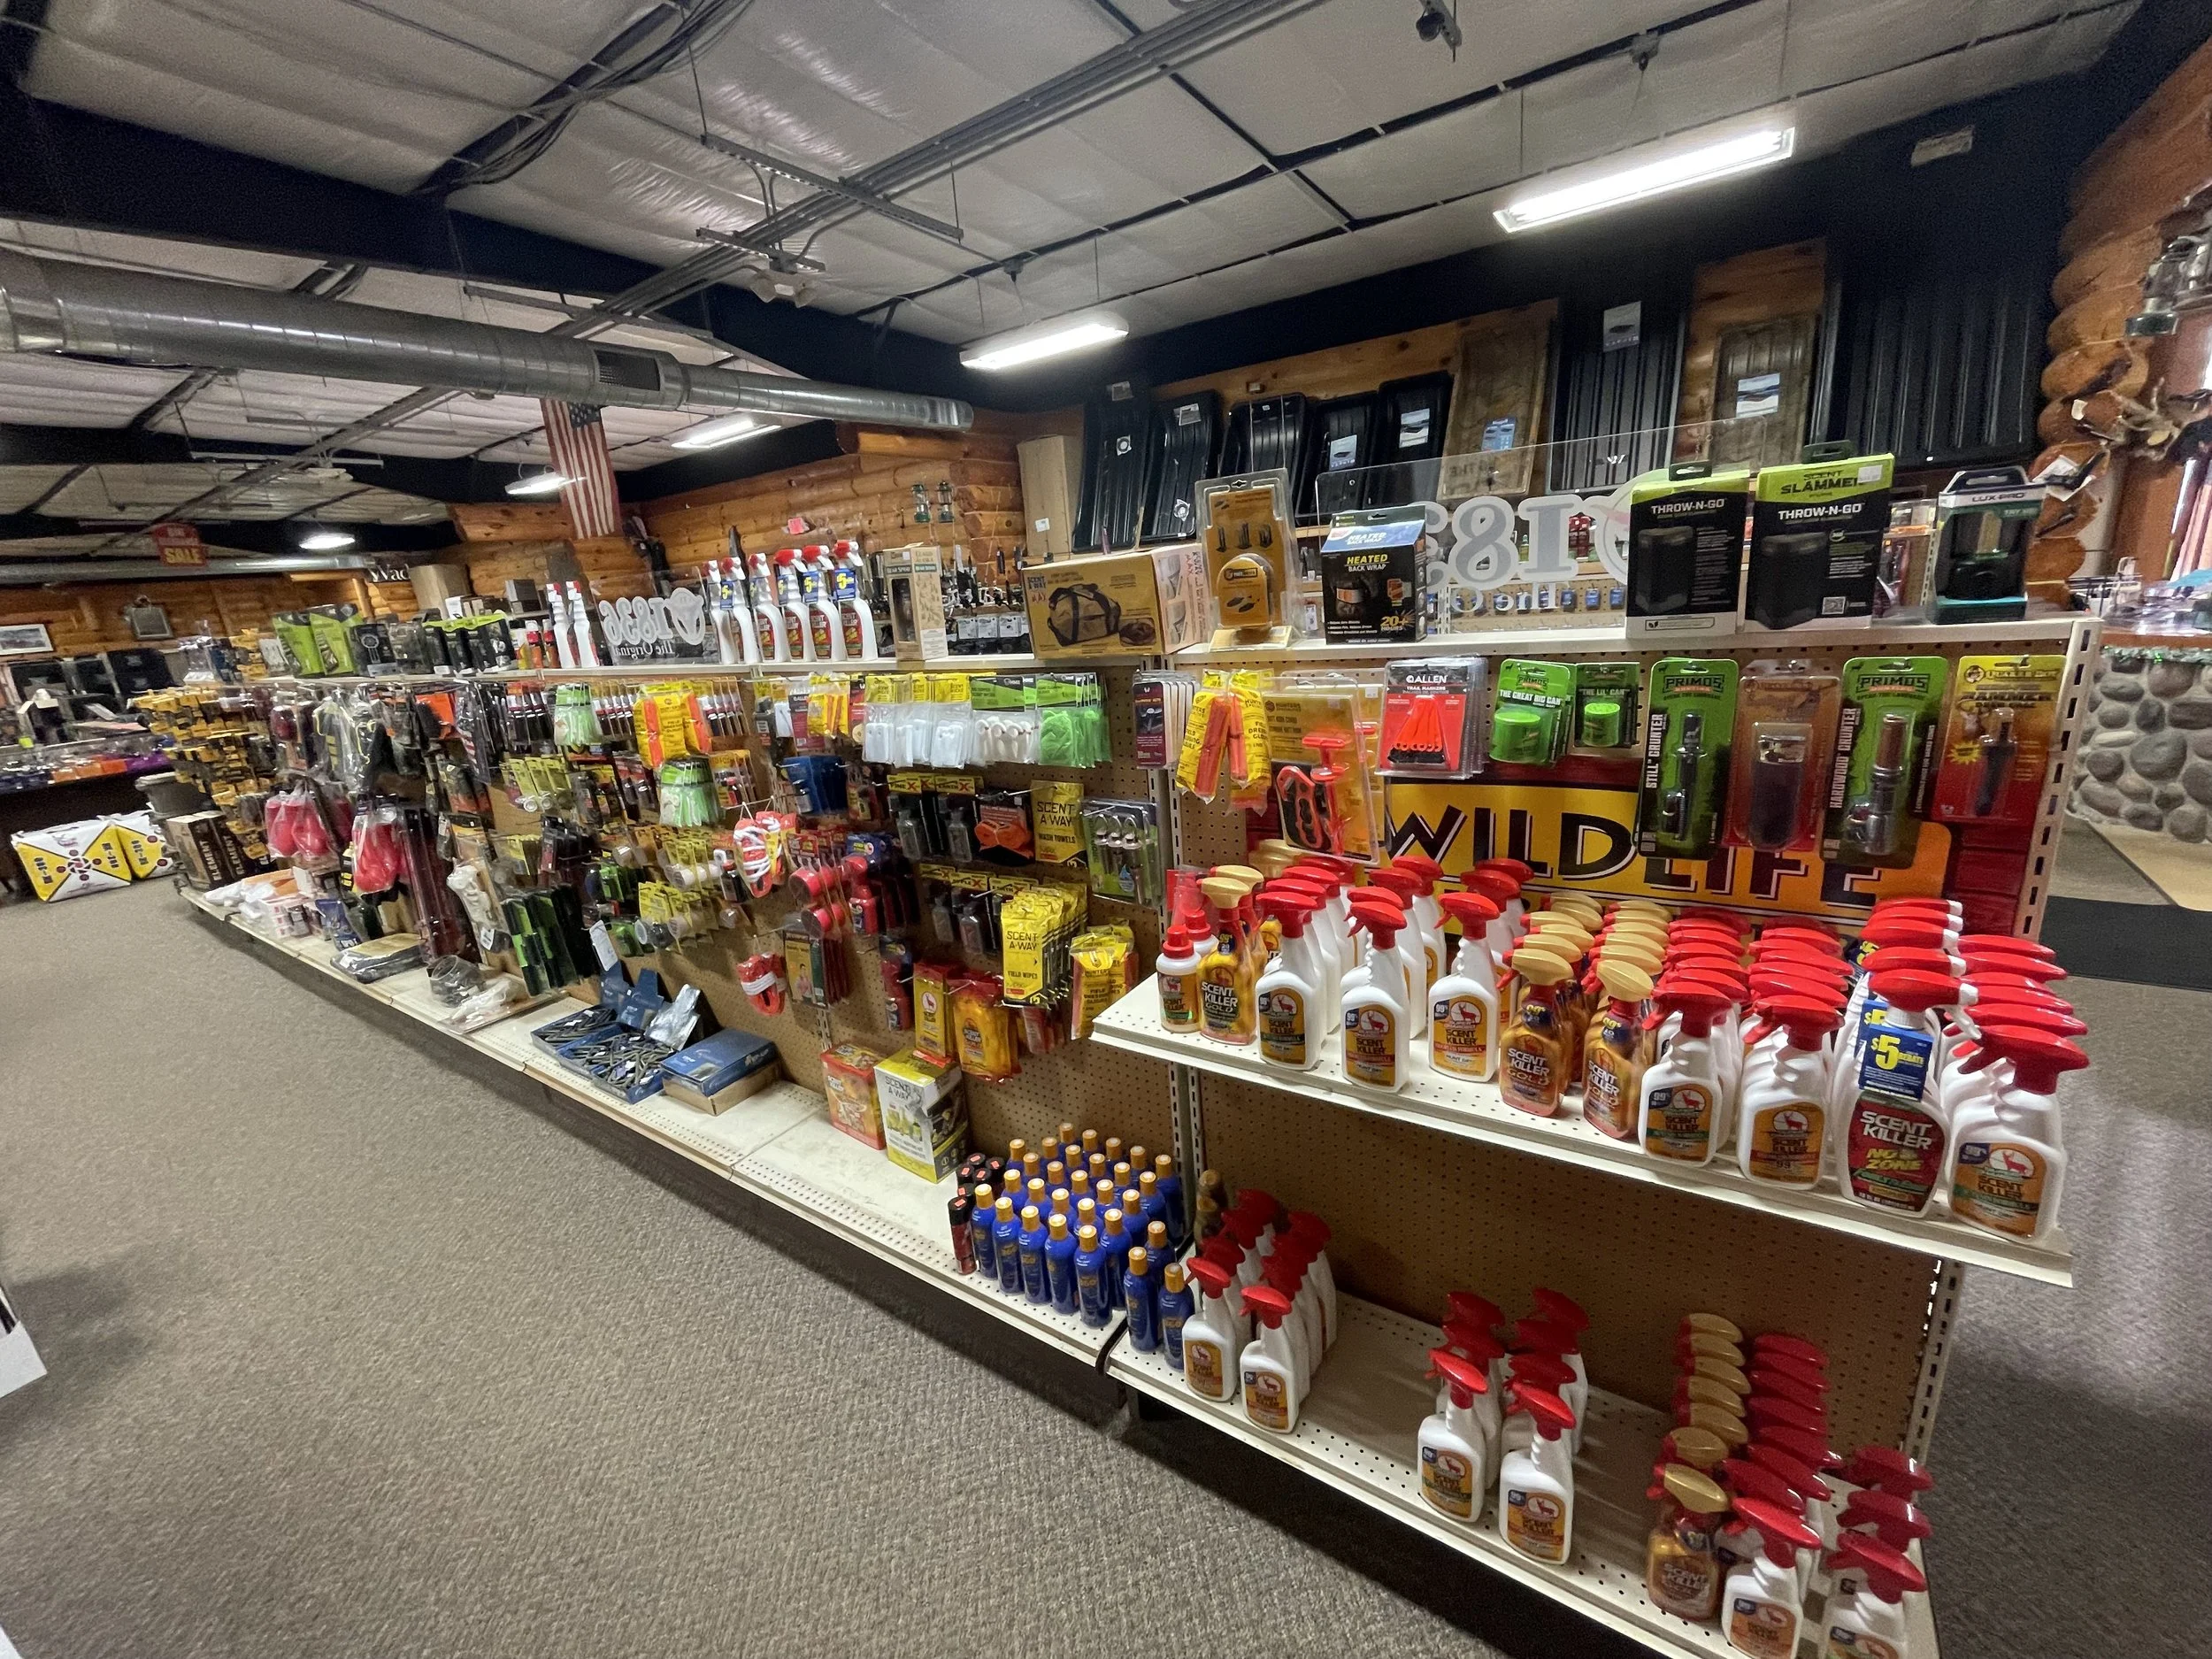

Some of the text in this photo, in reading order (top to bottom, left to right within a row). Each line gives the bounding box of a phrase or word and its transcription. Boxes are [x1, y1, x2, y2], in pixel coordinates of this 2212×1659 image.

[1803, 470, 1843, 481] SCENT
[1651, 498, 1725, 516] THROW-N-GO
[1778, 503, 1863, 520] THROW-N-GO
[1347, 554, 1388, 565] HEATED
[1415, 674, 1448, 684] ALLEN
[1666, 677, 1722, 689] PRIMOS
[1860, 676, 1926, 688] PRIMOS
[1500, 689, 1511, 698] THE
[1512, 690, 1533, 702] GREAT
[1534, 694, 1546, 703] BIG
[1547, 695, 1562, 705] CAN
[1645, 713, 1663, 789] STILL GRUNTER
[1829, 707, 1856, 809] HARDWOOD GRUNTER
[1037, 801, 1075, 815] SCENT
[1039, 833, 1076, 844] WASH TOWELS
[1007, 930, 1039, 941] SCENT
[1201, 982, 1236, 997] SCENT
[1203, 992, 1238, 1008] KILLER
[1204, 1002, 1233, 1014] GOLD
[1269, 1025, 1295, 1034] KILLER
[1445, 1029, 1476, 1039] SCENT
[1356, 1039, 1385, 1048] SCENT
[1446, 1037, 1478, 1046] KILLER
[1356, 1046, 1386, 1055] KILLER
[1507, 1048, 1547, 1065] SCENT
[1510, 1057, 1550, 1076] KILLER
[1588, 1060, 1618, 1085] SCENT
[885, 1076, 910, 1092] SCENT
[1507, 1068, 1550, 1086] GOLD
[1588, 1071, 1620, 1097] KILLER
[1664, 1116, 1699, 1125] SCENT
[1860, 1110, 1933, 1138] SCENT
[1862, 1123, 1933, 1150] KILLER
[1867, 1158, 1922, 1171] ZONE
[1978, 1173, 2024, 1191] SCENT
[1978, 1184, 2022, 1199] KILLER
